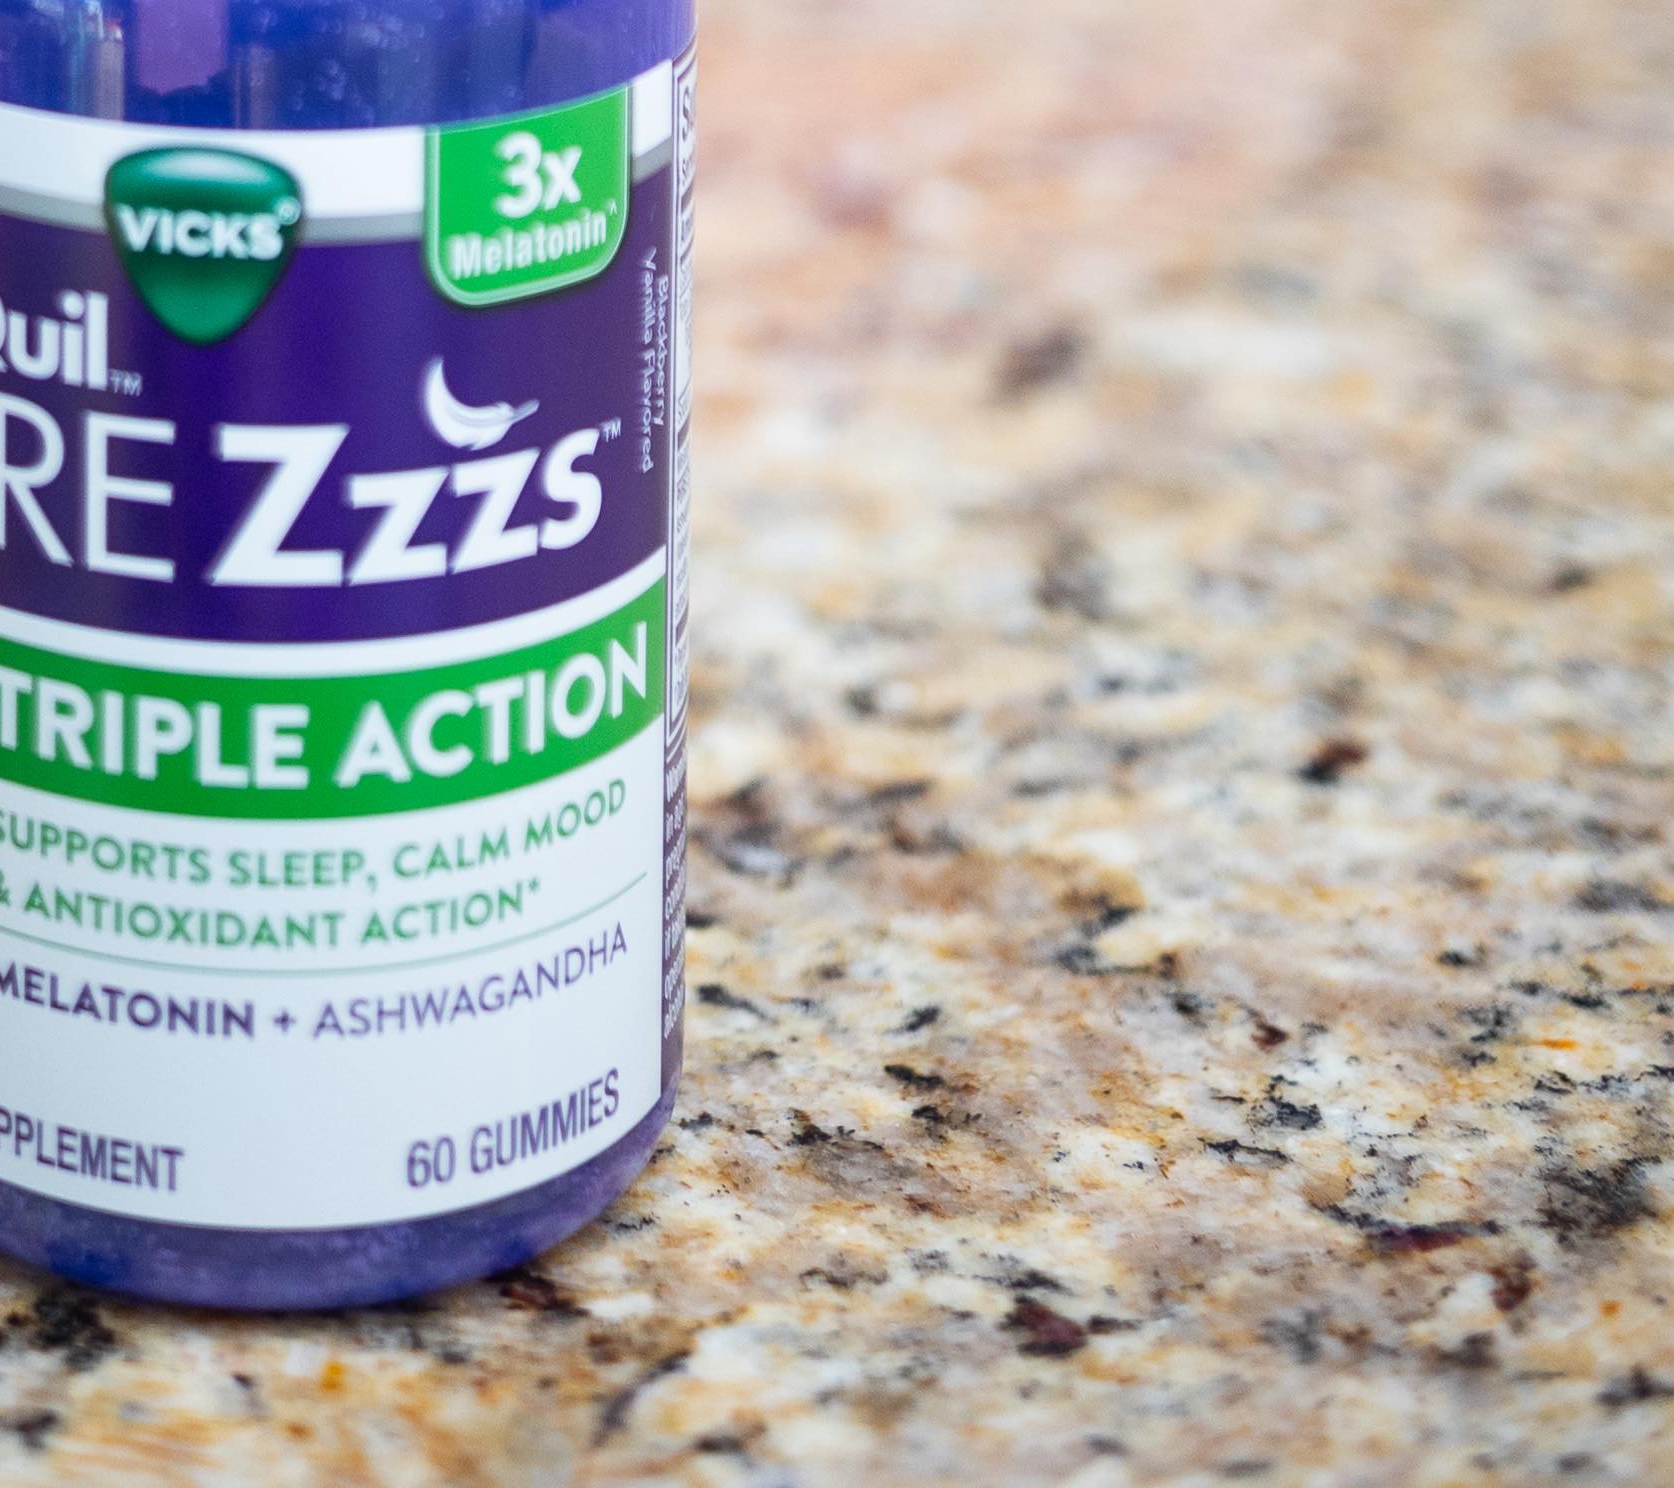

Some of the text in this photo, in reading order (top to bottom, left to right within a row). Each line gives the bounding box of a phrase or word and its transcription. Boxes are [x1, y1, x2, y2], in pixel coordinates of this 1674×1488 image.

[493, 130, 582, 220] 3x
[638, 245, 658, 474] Vanilla Flavored
[652, 274, 669, 428] Blackberry
[336, 621, 648, 788] ACTION
[228, 850, 378, 894] SLEEP,
[392, 829, 512, 878] CALM
[524, 777, 627, 854] MOOD
[24, 883, 345, 949] ANTIOXIDANT
[272, 1009, 297, 1035] +
[312, 921, 628, 1039] ASHWAGANDHA
[406, 1068, 622, 1190] 60 GUMMIES
